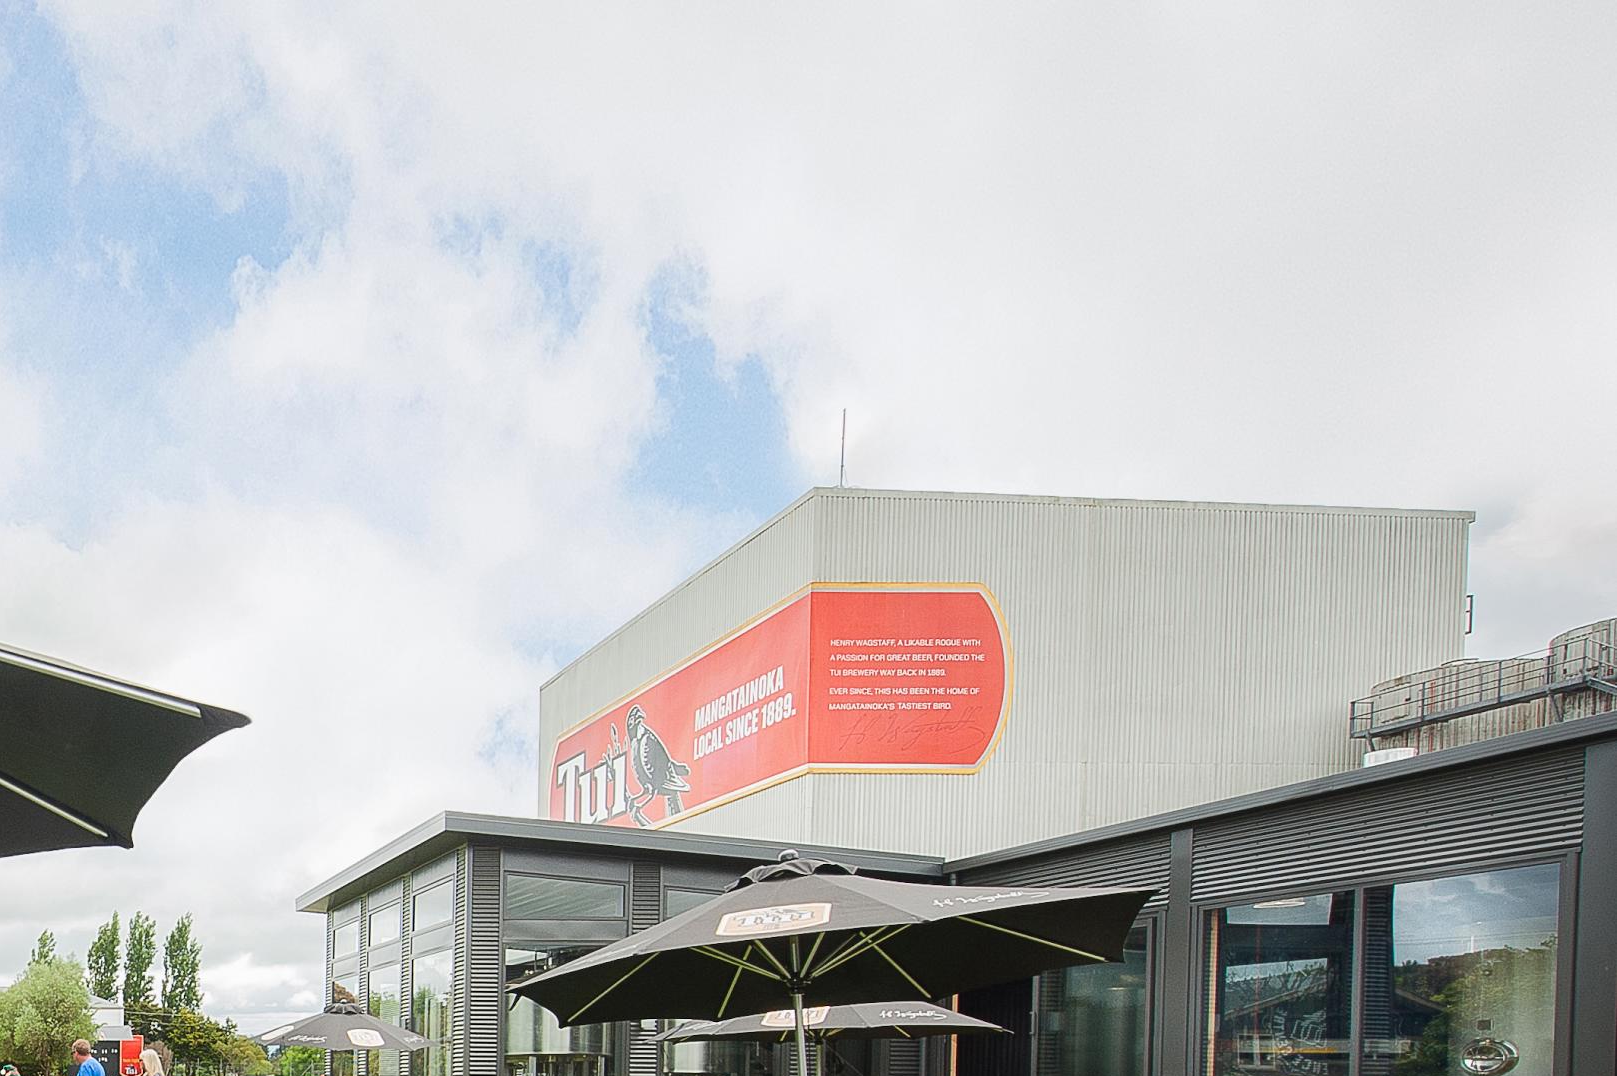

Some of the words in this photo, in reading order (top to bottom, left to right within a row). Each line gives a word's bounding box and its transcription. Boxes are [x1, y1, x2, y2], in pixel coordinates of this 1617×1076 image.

[830, 639, 855, 647] HENRY
[855, 639, 896, 647] WAGSTAFF,
[897, 639, 903, 647] A
[904, 639, 934, 647] LIKABLE
[935, 639, 961, 647] ROGUE
[962, 639, 981, 647] WITH
[830, 654, 836, 662] A
[836, 654, 868, 662] PASSION
[870, 654, 885, 662] FOR
[887, 654, 910, 662] GREAT
[912, 654, 933, 662] BEER,
[934, 654, 969, 662] FOUNDED
[971, 654, 985, 662] THE
[693, 731, 723, 761] LOCAL
[725, 709, 759, 746] SINCE
[761, 692, 797, 728] 1889.
[695, 665, 784, 732] MANGATAINOKA
[557, 751, 627, 823] Tui
